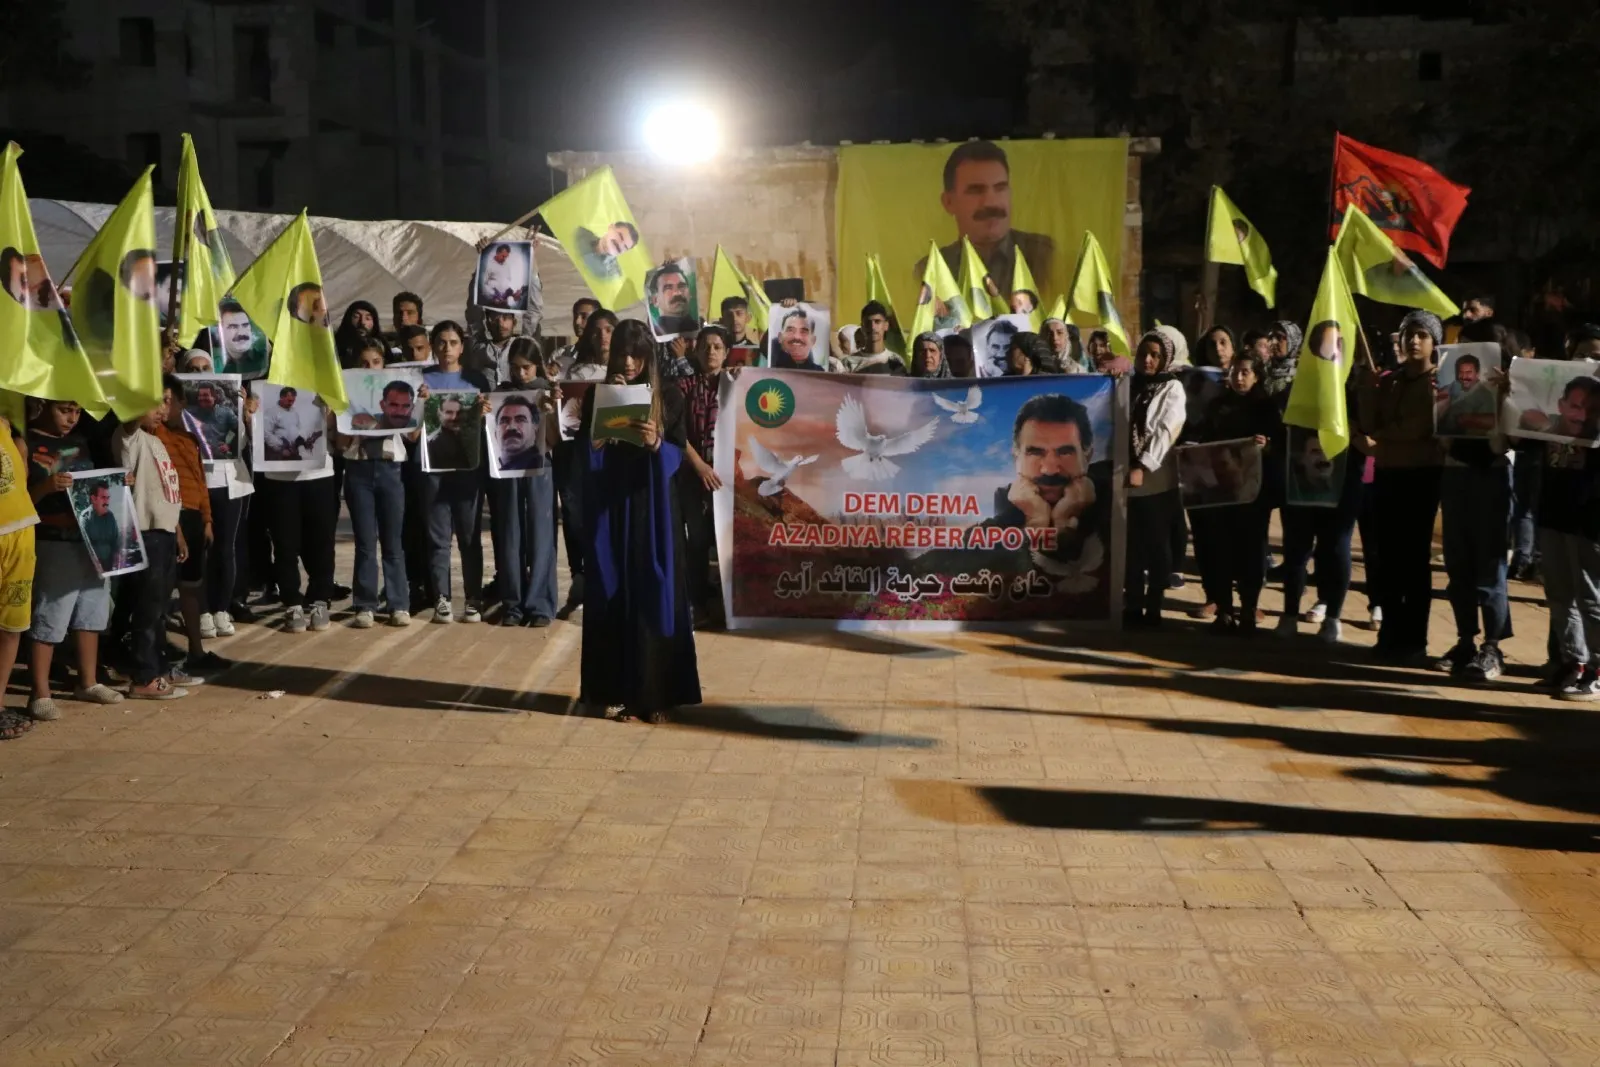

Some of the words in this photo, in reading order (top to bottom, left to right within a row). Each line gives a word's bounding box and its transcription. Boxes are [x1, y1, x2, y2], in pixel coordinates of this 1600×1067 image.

[843, 491, 900, 516] DEM
[905, 493, 981, 516] DEMA
[769, 523, 881, 547] AZADIYA
[885, 521, 964, 549] RÊBER
[968, 526, 1024, 550] APO
[1027, 527, 1058, 549] YE
[774, 561, 813, 599] آبو
[817, 564, 881, 597] القائد
[885, 566, 944, 601] حرية
[950, 568, 1003, 600] وقت
[1008, 569, 1053, 603] حان
